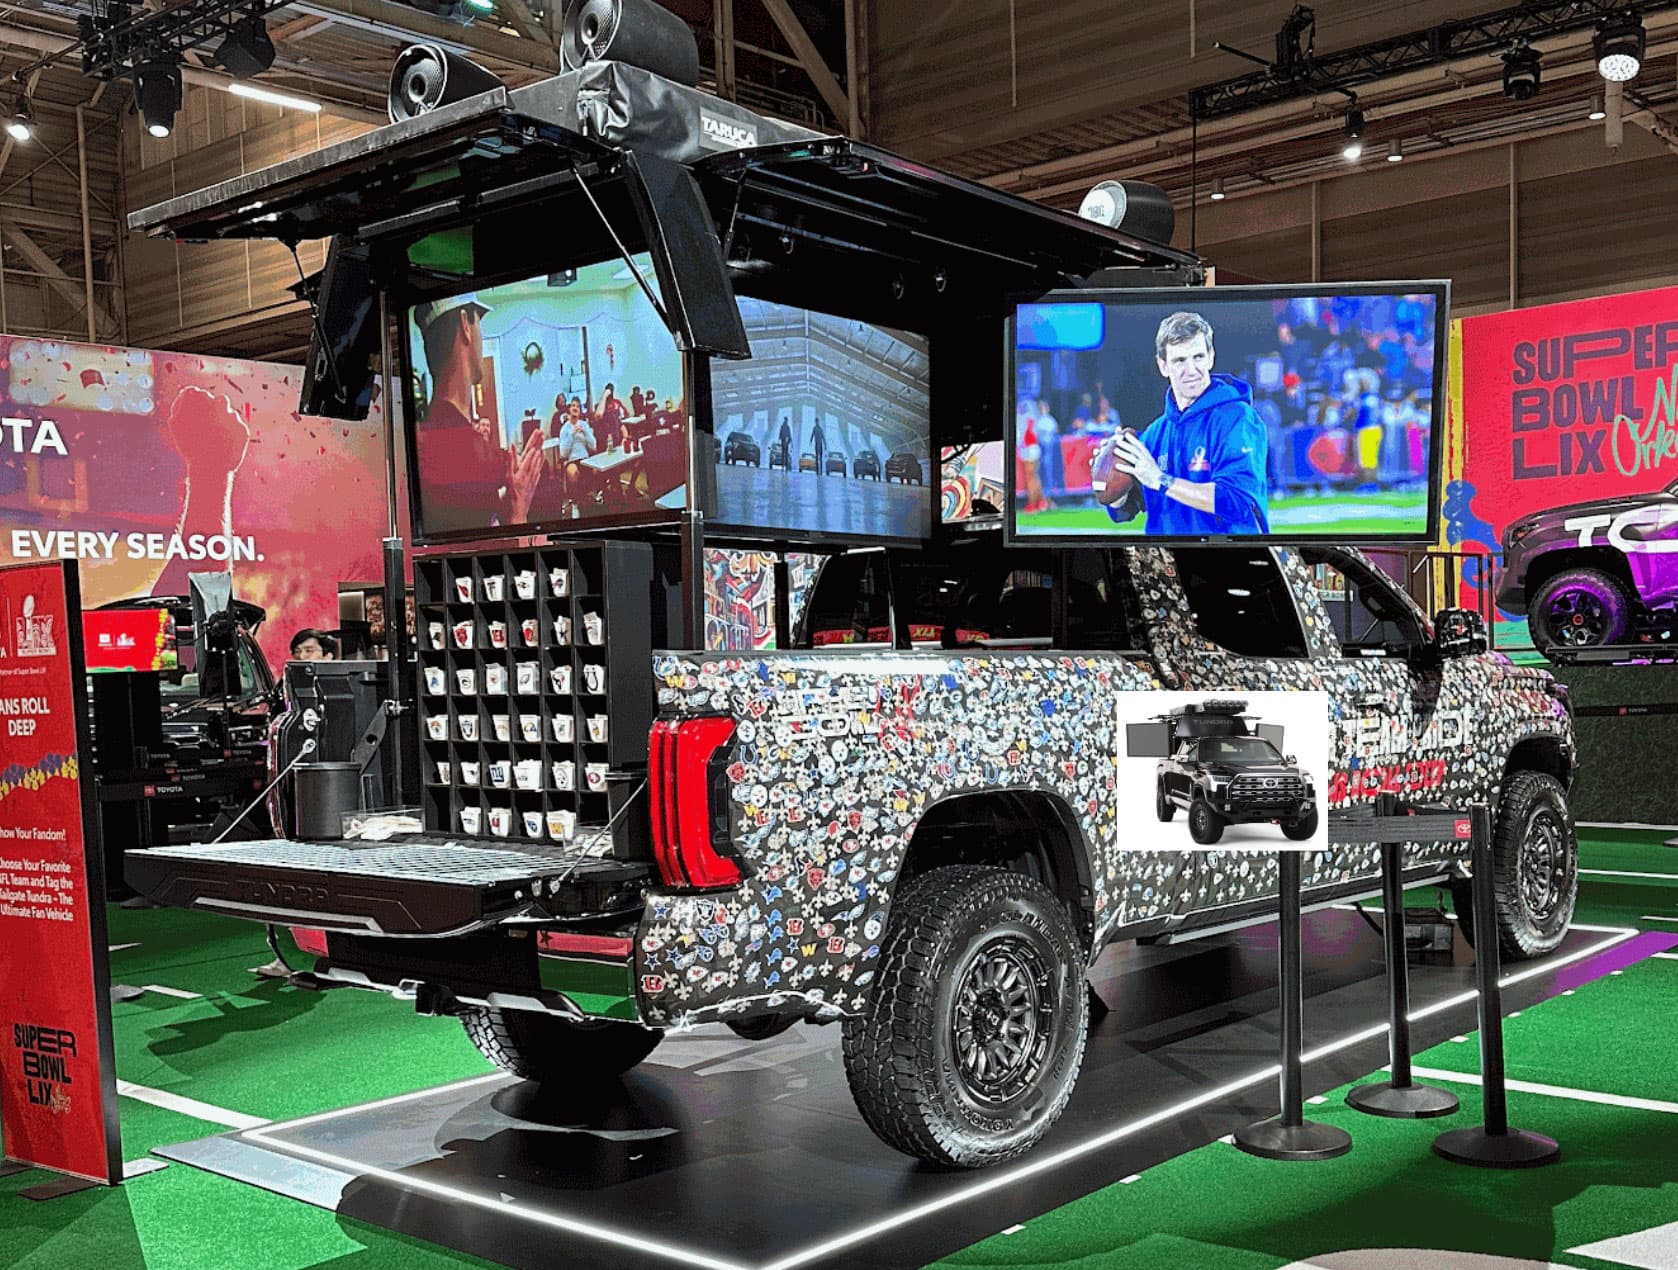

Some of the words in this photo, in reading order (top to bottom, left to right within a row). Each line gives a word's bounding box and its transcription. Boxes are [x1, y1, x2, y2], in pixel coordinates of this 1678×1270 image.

[1512, 375, 1643, 433] BOWL
[0, 417, 69, 456] TA
[1512, 428, 1608, 480] LIX
[11, 529, 119, 559] EVERY
[127, 532, 265, 562] SEASON.
[21, 697, 51, 714] ROLL
[8, 719, 36, 736] DEEP
[157, 785, 183, 793] TOYOTA
[15, 826, 32, 839] Your
[32, 827, 66, 841] Fandom!
[22, 857, 40, 871] Your
[40, 859, 71, 874] Favorite
[10, 873, 30, 886] Team
[30, 875, 45, 887] and
[45, 876, 59, 892] Tag
[60, 876, 73, 890] the
[26, 890, 52, 904] Tundra
[58, 892, 73, 905] The
[1, 903, 31, 917] Ultimate
[31, 906, 46, 919] Fan
[45, 907, 73, 922] Vehicle
[14, 1023, 77, 1057] SUPER
[22, 1052, 72, 1084] BOWL
[27, 1079, 52, 1106] LIX
